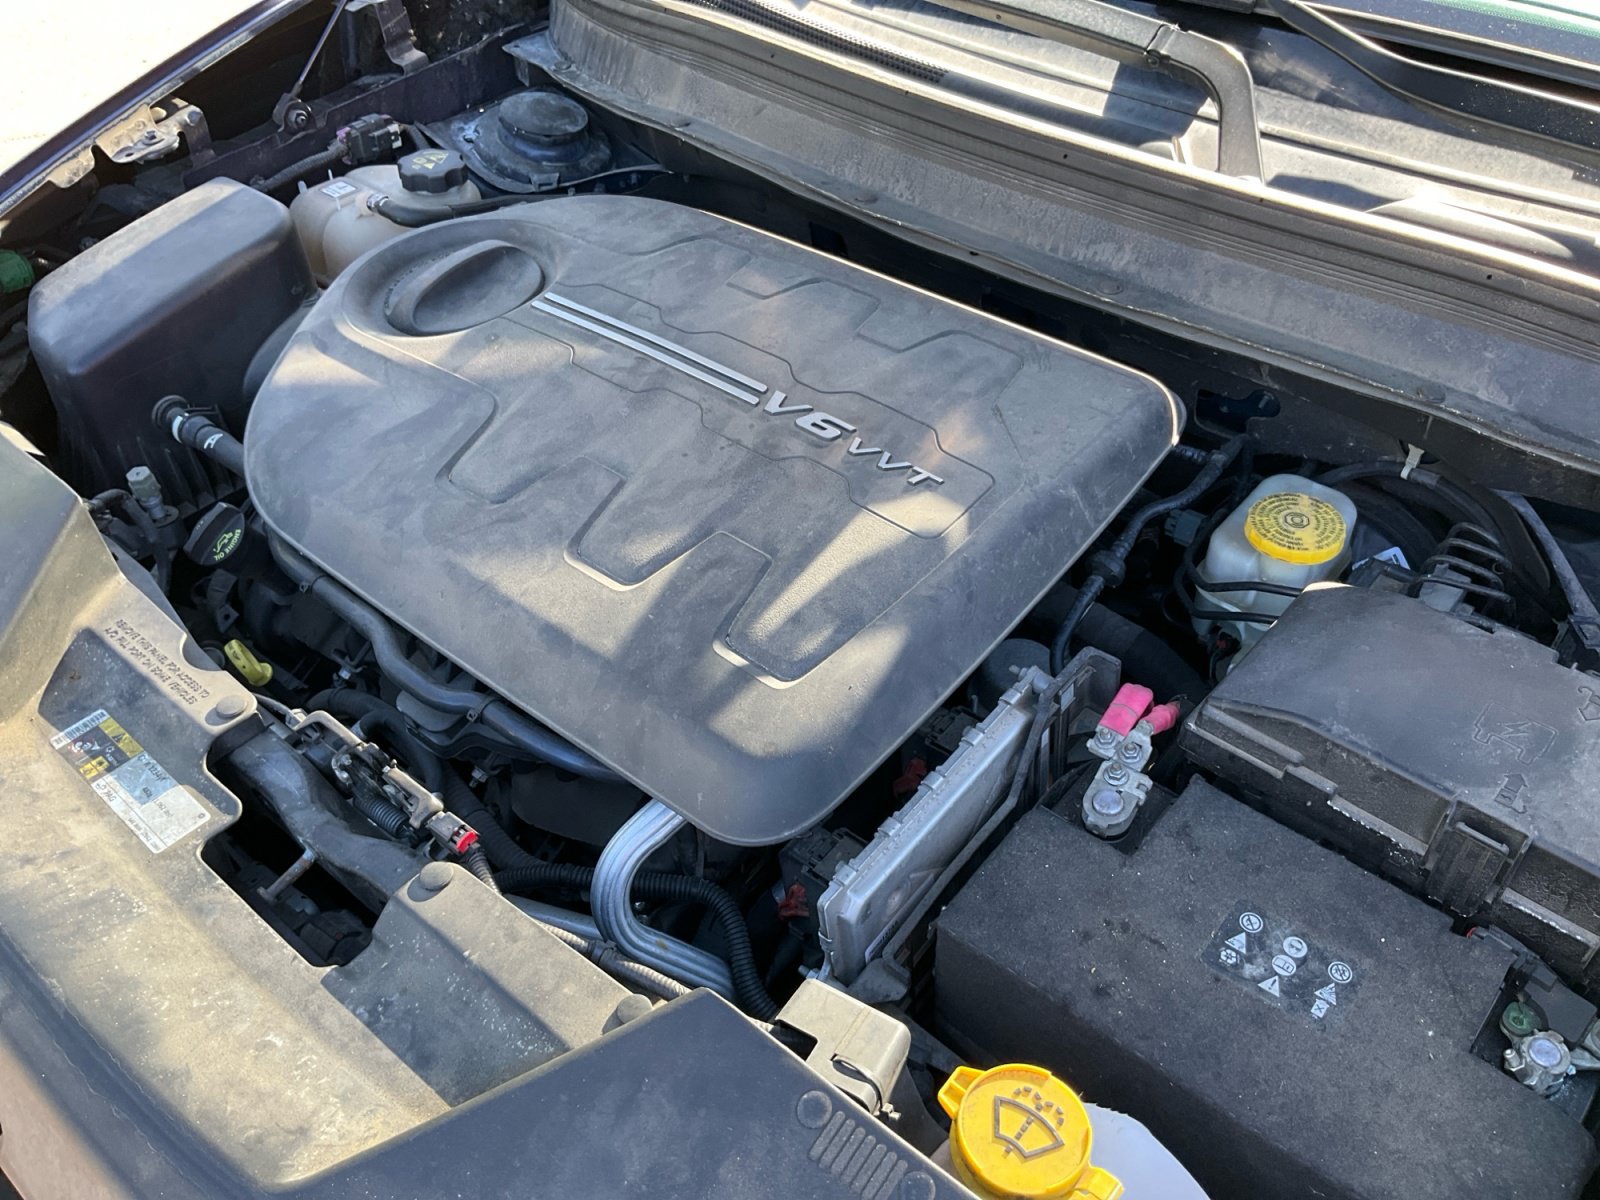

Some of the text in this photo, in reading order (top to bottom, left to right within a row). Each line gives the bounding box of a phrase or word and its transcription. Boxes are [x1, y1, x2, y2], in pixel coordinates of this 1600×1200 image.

[763, 390, 945, 486] V6 VVT
[213, 529, 241, 561] ENGINE OIL
[116, 619, 210, 699] REMOVE THIS PANEL FOR ACCESS TO
[117, 636, 130, 649] FILL
[128, 646, 146, 659] PORT
[142, 658, 156, 669] ON
[150, 665, 172, 683] SOME
[168, 681, 198, 705] VEHICLES
